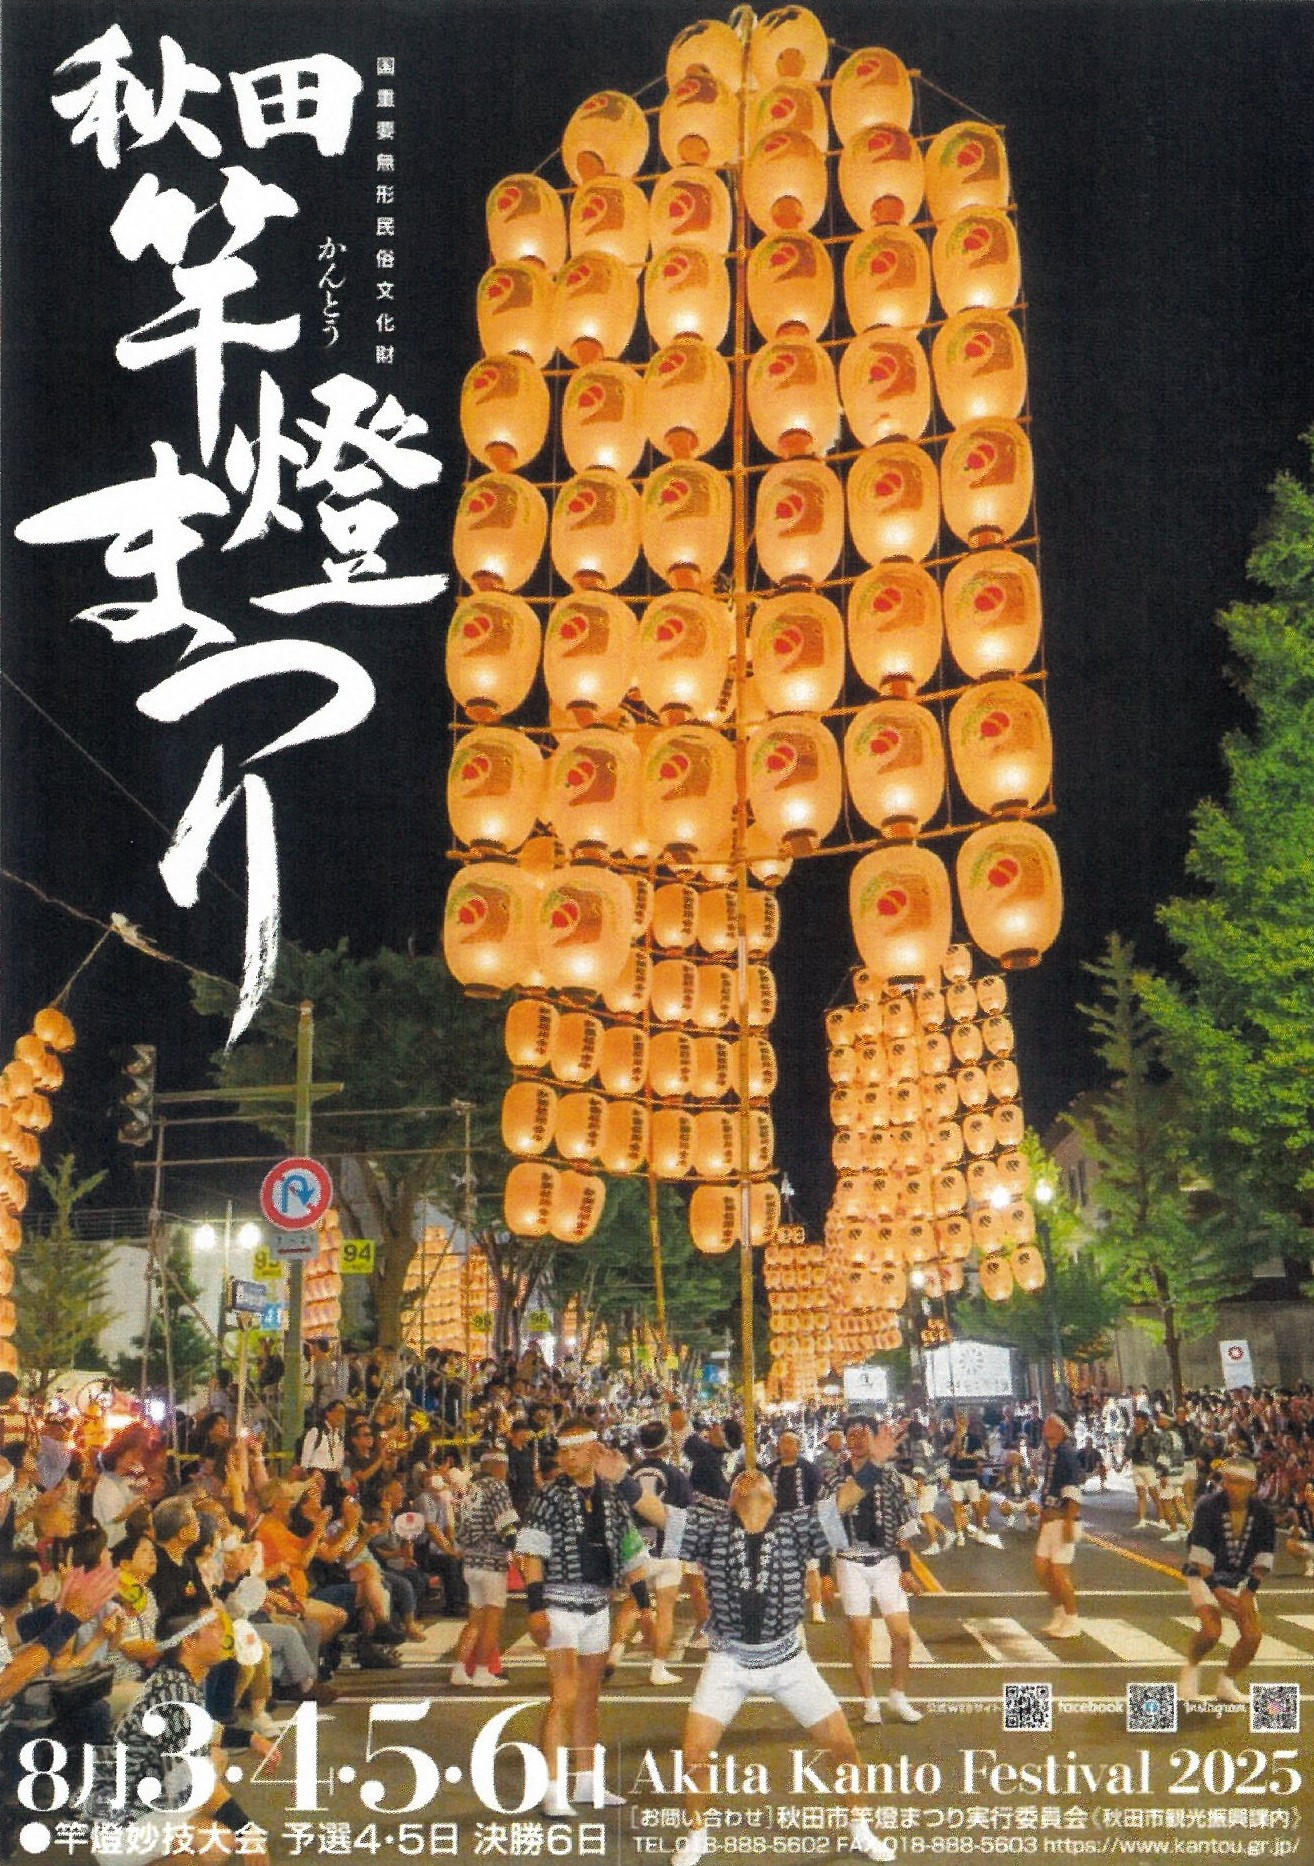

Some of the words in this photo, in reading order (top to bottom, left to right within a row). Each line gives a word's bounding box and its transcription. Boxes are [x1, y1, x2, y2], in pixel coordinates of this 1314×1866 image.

[51, 23, 362, 168] 秋田
[376, 57, 395, 364] 国重要無形民俗文化財
[318, 236, 347, 348] かんとう
[343, 1243, 371, 1262] 94
[628, 1748, 770, 1796] Akita
[788, 1748, 943, 1796] Kanto
[958, 1748, 1152, 1796] Festival
[1168, 1748, 1303, 1796] 2025
[473, 1822, 607, 1855] 決勝6日
